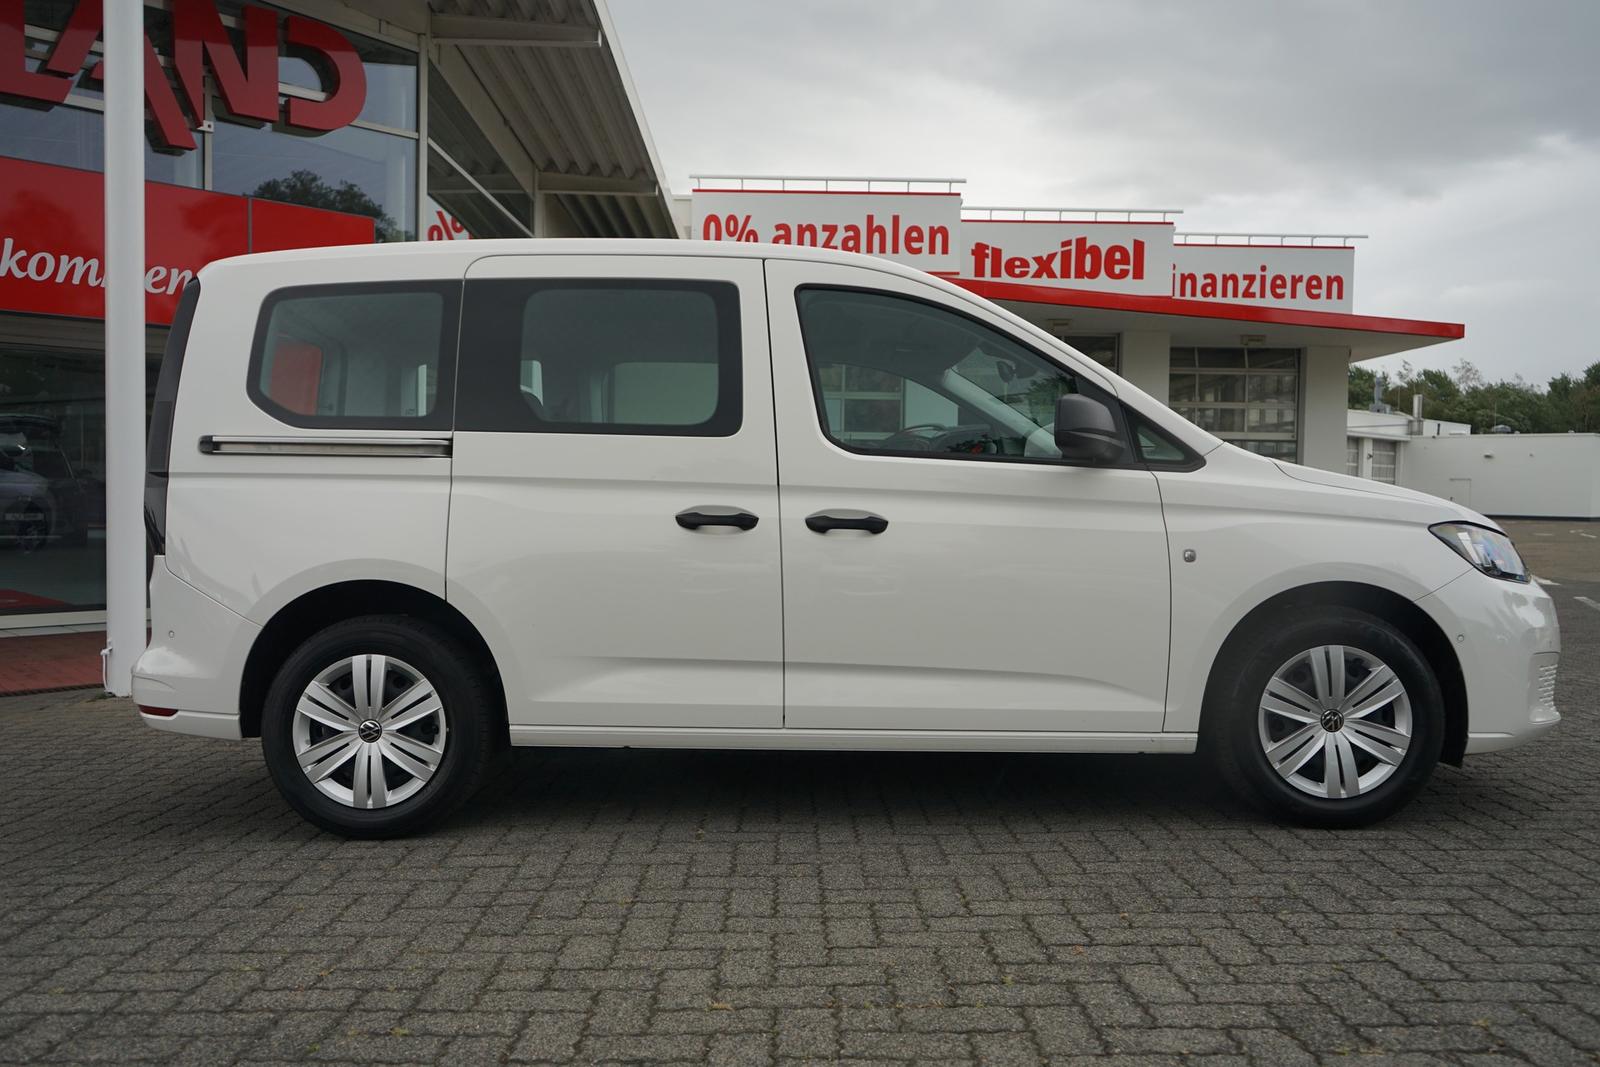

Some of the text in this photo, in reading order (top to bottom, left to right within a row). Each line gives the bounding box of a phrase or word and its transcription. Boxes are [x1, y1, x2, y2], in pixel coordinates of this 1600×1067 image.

[702, 213, 949, 255] 0% anzahlen
[0, 238, 193, 295] komen
[971, 236, 1145, 281] flexibel
[1172, 264, 1344, 300] inanzieren
